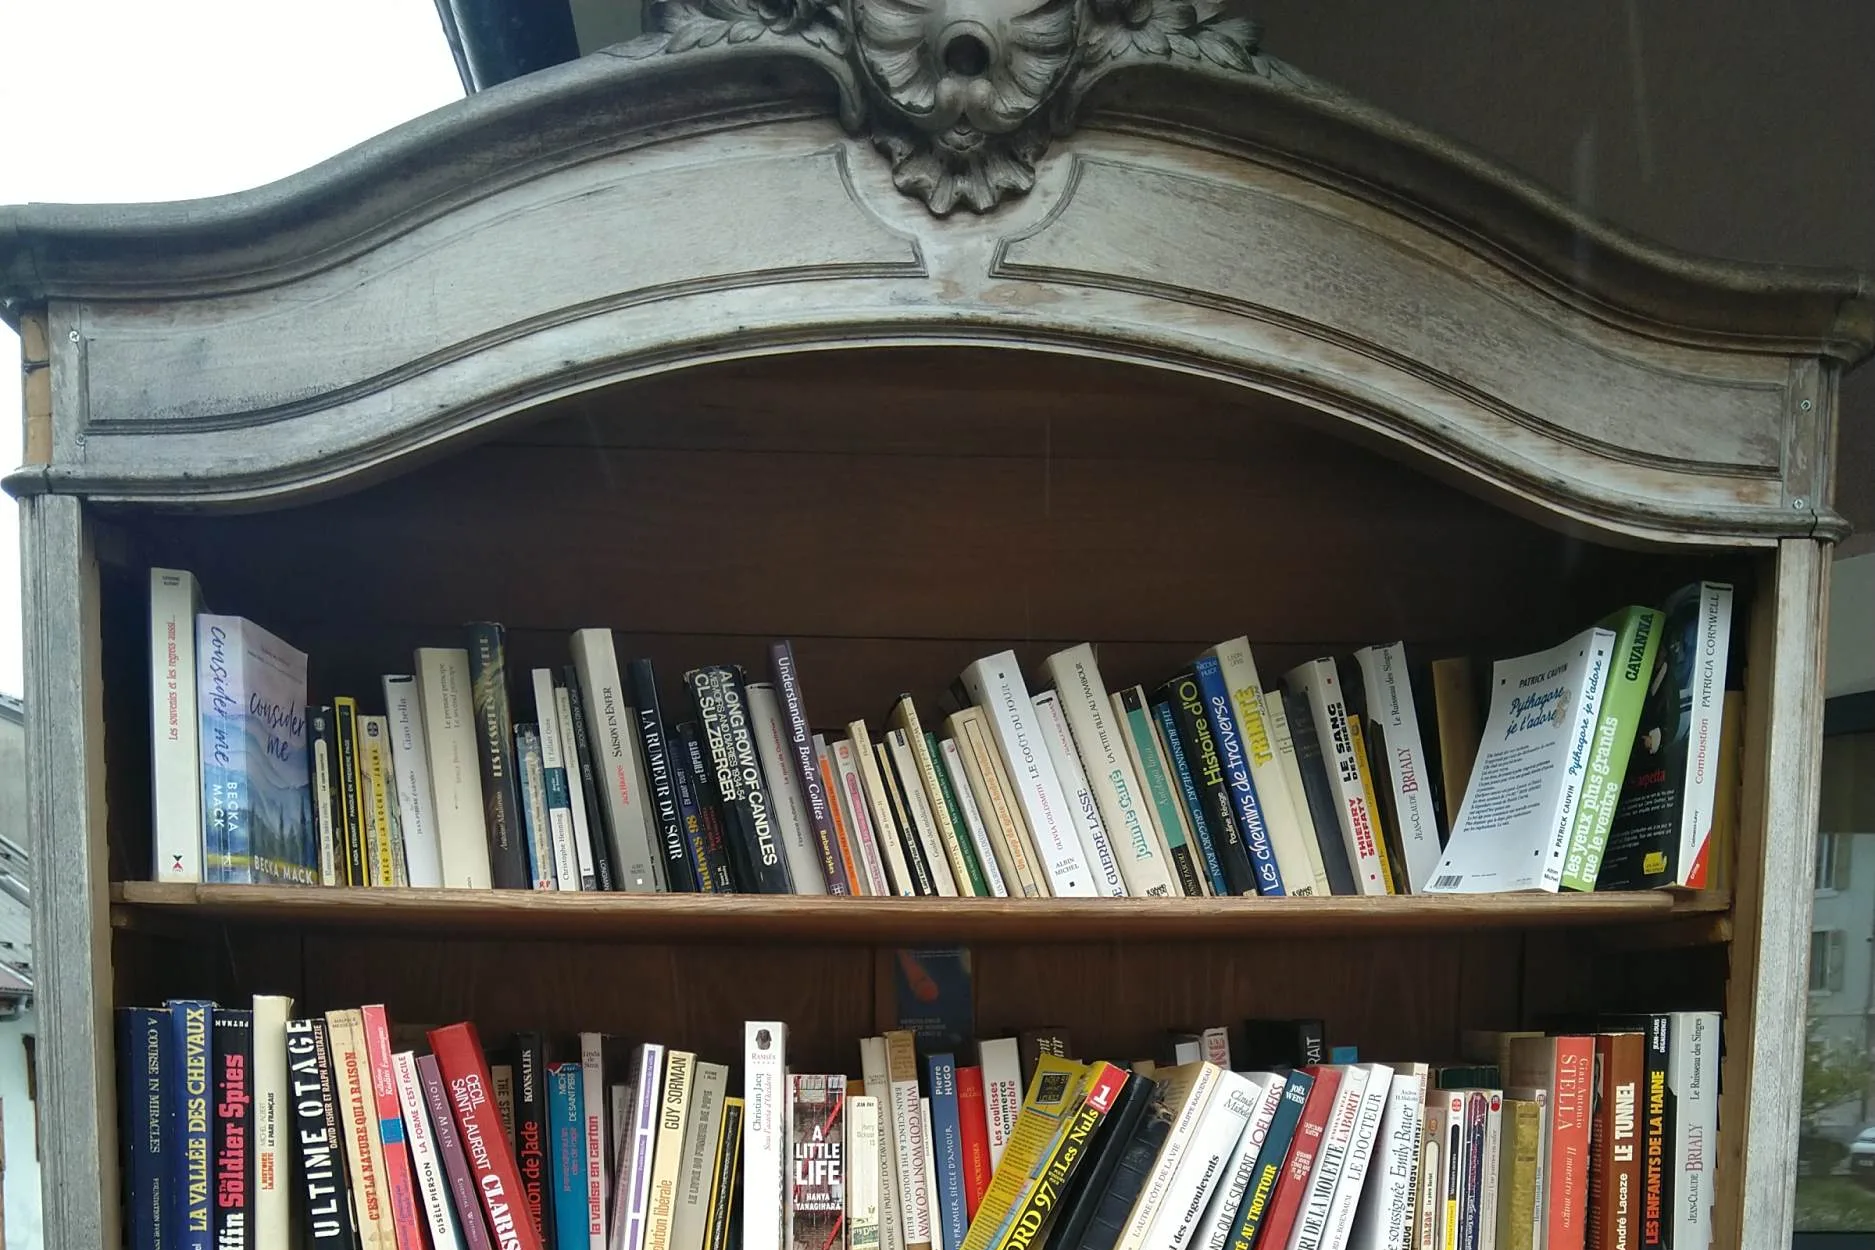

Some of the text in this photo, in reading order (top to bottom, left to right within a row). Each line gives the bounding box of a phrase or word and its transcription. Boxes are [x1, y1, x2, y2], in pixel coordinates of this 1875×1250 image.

[167, 643, 178, 666] regrets
[168, 669, 177, 679] les
[1624, 613, 1655, 682] CAVANNA
[1701, 593, 1720, 708] PATRICIA CORNWELL
[168, 691, 178, 725] souvenirs
[169, 728, 178, 740] Les
[778, 657, 826, 820] Understanding Border Collies
[640, 709, 682, 860] LA RUMEUR DU SOIR
[719, 670, 778, 865] A LONG ROW OF CANDLES
[1163, 709, 1197, 801] THE BURNING HEART
[1694, 718, 1710, 784] Combustion
[1212, 696, 1279, 892] Les chemins de traverse
[1564, 717, 1619, 878] les yeux plus grands
[819, 830, 836, 874] Barbara Sykes
[1193, 809, 1220, 877] GREGORY RYAN
[1581, 782, 1619, 883] que le ventre
[254, 856, 313, 885] BECKA MACK
[398, 1056, 428, 1153] LA FORME C'EST FACILE
[521, 1050, 533, 1103] KONSALIK
[664, 1057, 686, 1130] GUY SORMAN
[186, 1008, 207, 1231] LA VALLÉE DES CHEVAUX
[218, 1054, 249, 1207] Soldier Spies
[286, 1018, 340, 1238] ULTIME OTAGE
[452, 1074, 490, 1170] CECIL SAINT-LAURENT
[795, 1125, 840, 1185] A LITTLE LIFE
[1055, 1108, 1099, 1171] Les Nuls
[1347, 1094, 1381, 1181] LE DOCTEUR
[1394, 1104, 1414, 1141] Bauer
[1614, 1083, 1635, 1161] LE TUNNEL
[587, 1115, 601, 1235] la valise en carton
[1247, 1164, 1277, 1221] TROTTOIR
[1388, 1143, 1410, 1177] Emily
[1646, 1071, 1665, 1244] LES ENFANTS DE LA HAINE
[424, 1162, 446, 1234] GISÈLE PIERSON
[1035, 1181, 1057, 1207] 97
[1387, 1182, 1406, 1241] soussignée
[1616, 1173, 1628, 1250] André Lacaze
[1241, 1223, 1254, 1240] AU
